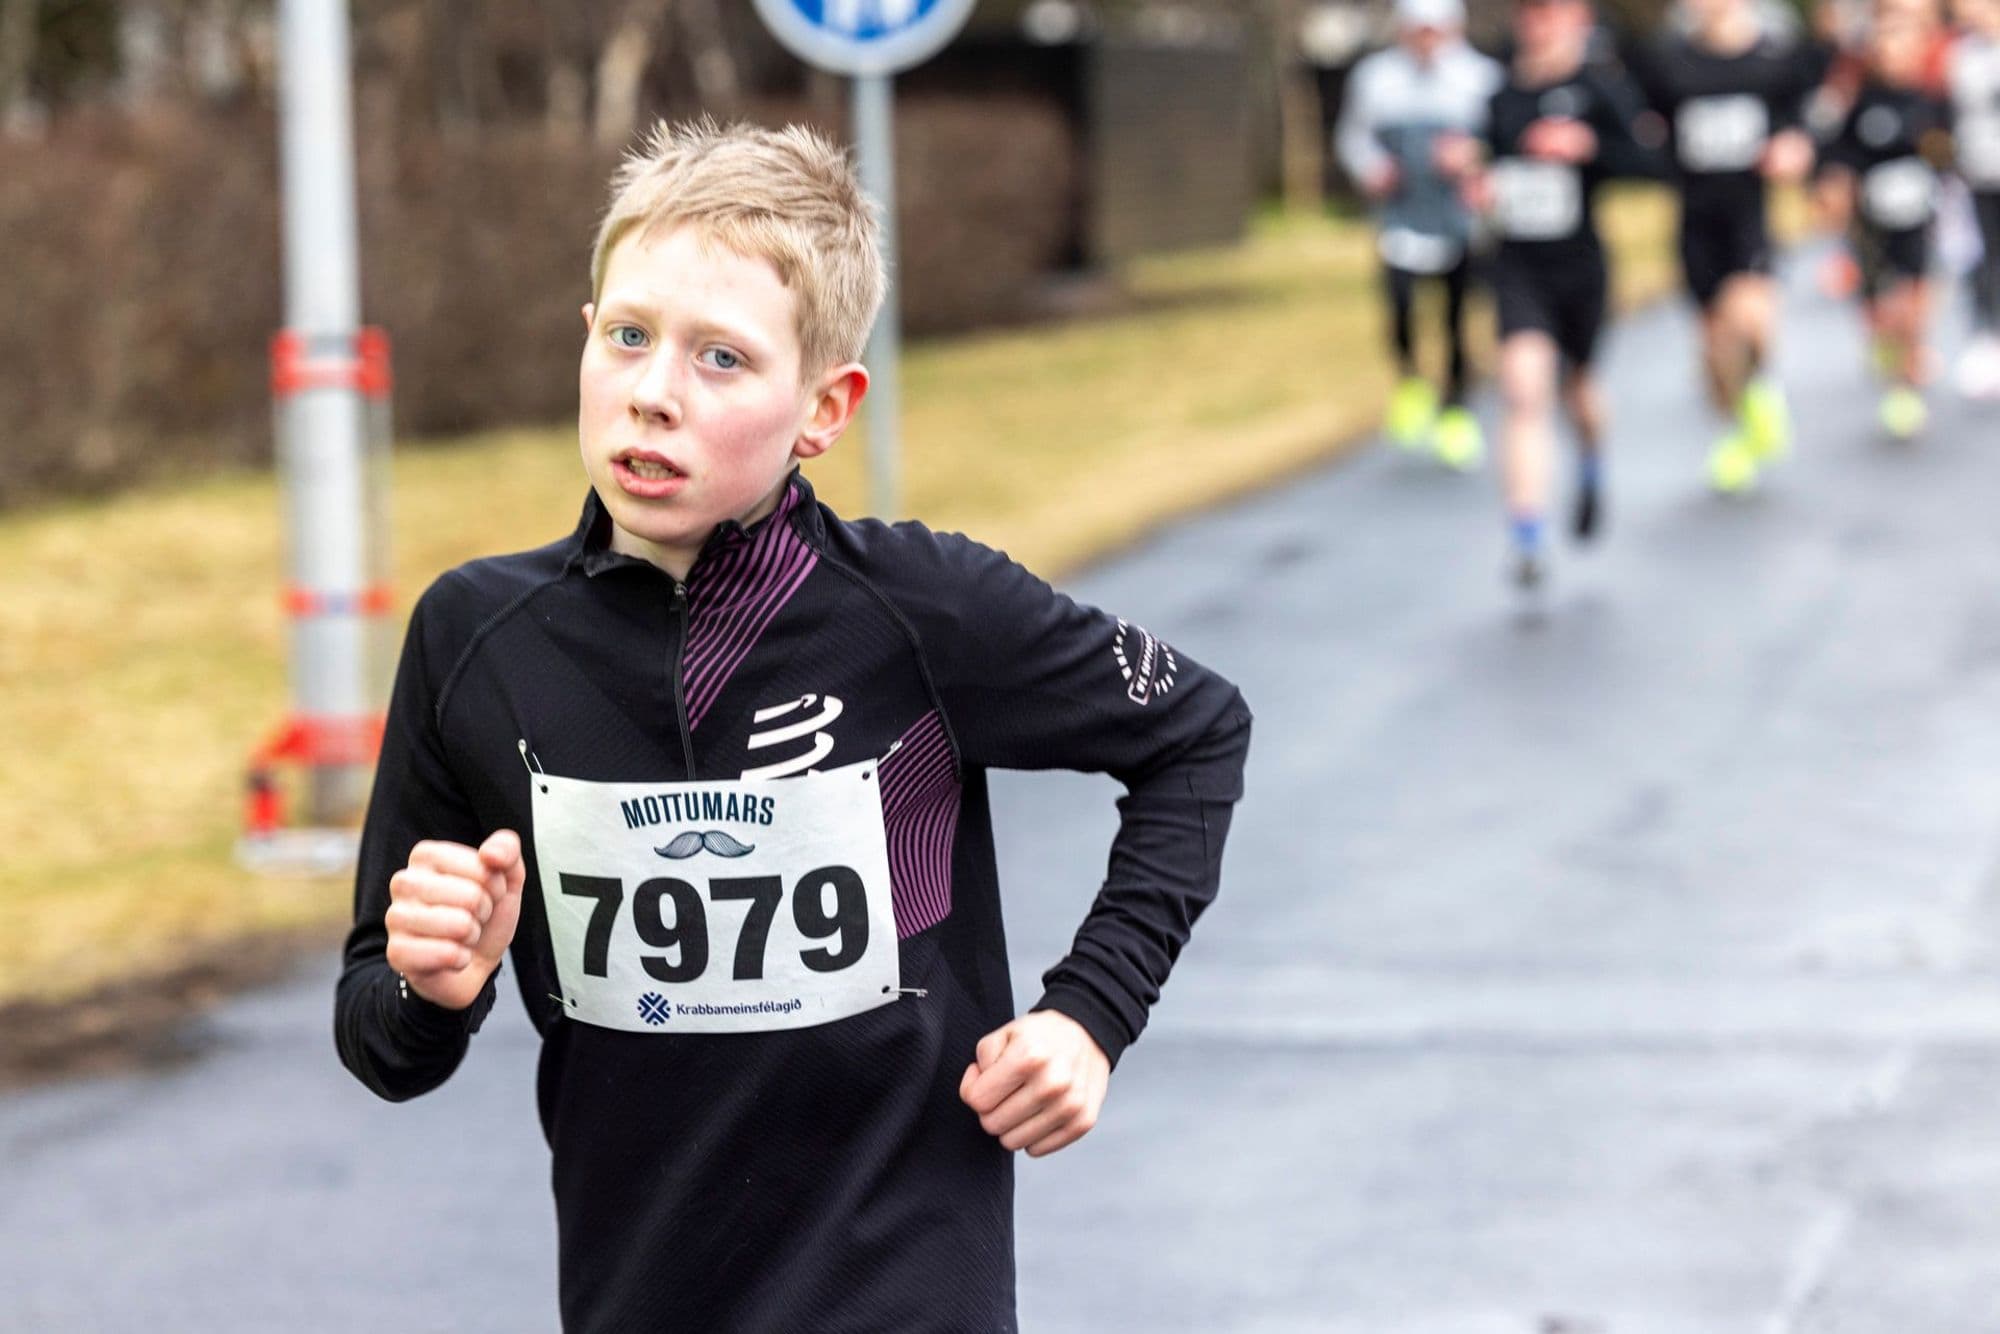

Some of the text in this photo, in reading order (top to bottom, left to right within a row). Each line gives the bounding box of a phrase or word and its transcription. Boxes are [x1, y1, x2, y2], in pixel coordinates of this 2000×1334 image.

[620, 791, 776, 830] MOTTUMARS
[559, 864, 869, 984] 7979
[676, 998, 802, 1015] Krabbameinsfélagið
